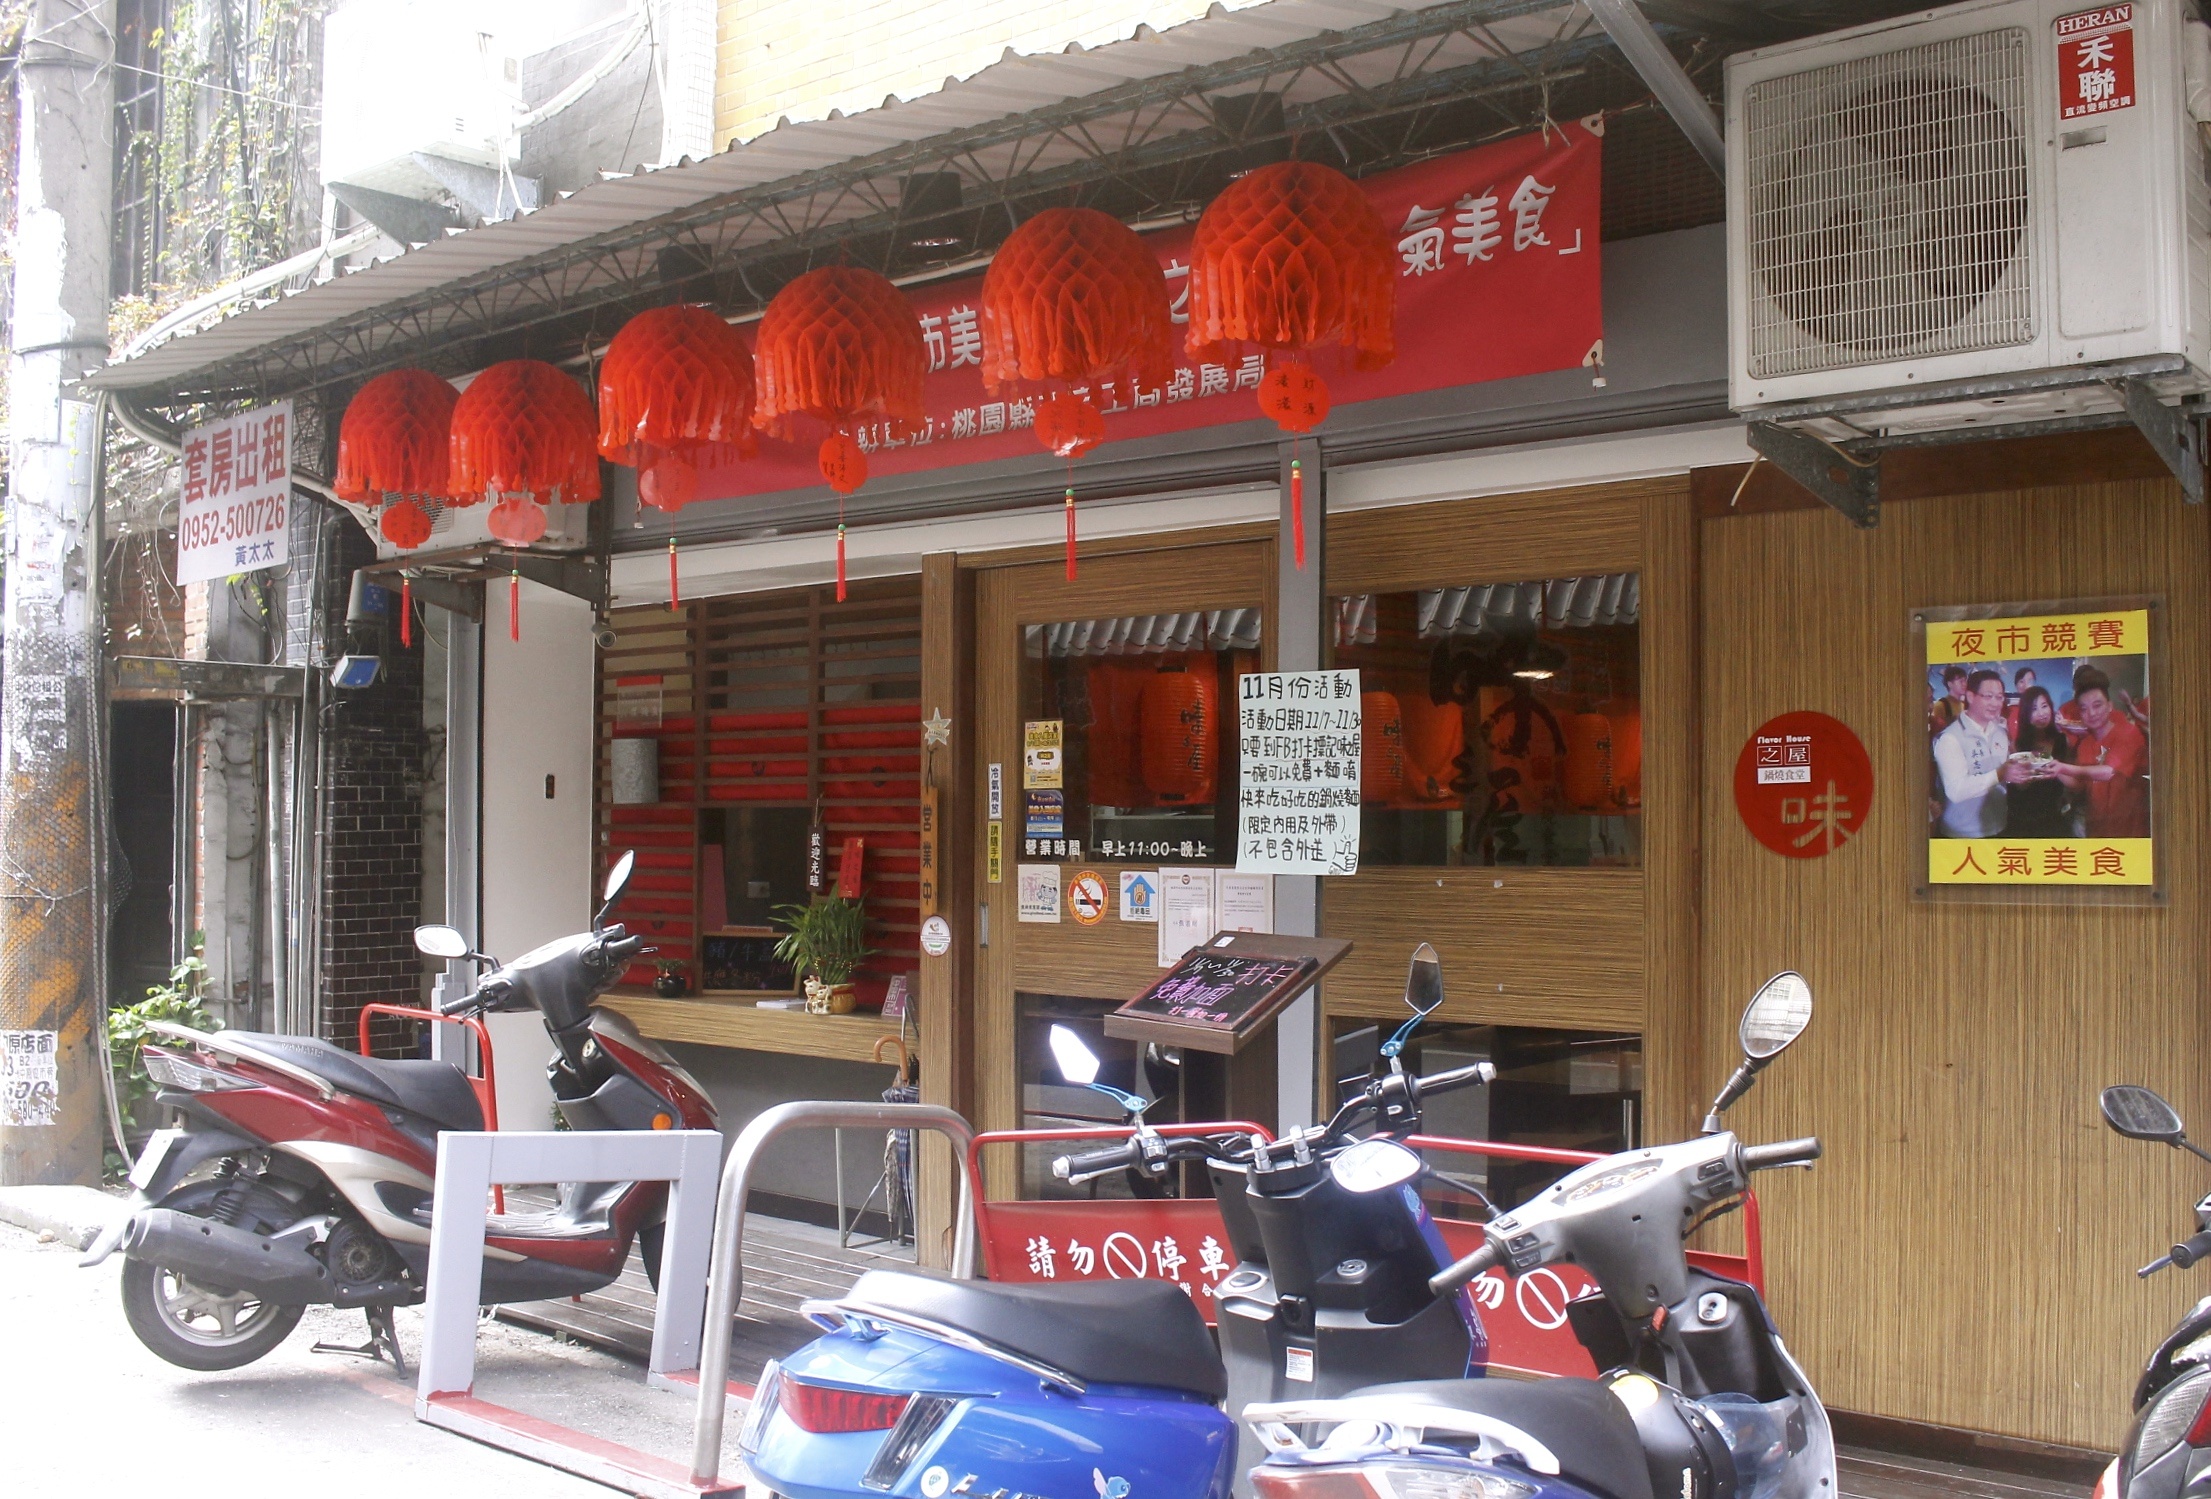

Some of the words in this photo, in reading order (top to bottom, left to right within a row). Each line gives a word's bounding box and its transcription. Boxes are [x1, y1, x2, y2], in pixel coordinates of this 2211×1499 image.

[2058, 6, 2130, 34] HERAN
[2076, 35, 2116, 103] 禾聯
[184, 413, 286, 505] 套房出租
[182, 493, 285, 552] 0952-500726
[235, 539, 275, 567] 黃太太
[1951, 619, 2124, 657] 夜市競賽
[1243, 672, 1353, 699] 11月份活動
[1760, 747, 1808, 763] 之屋
[809, 832, 821, 887] 歡迎光臨
[1025, 839, 1081, 856] 營業時間
[1952, 846, 2126, 877] 人氣美食
[1026, 1235, 1096, 1279] 請勿
[1151, 1235, 1230, 1281] 停車
